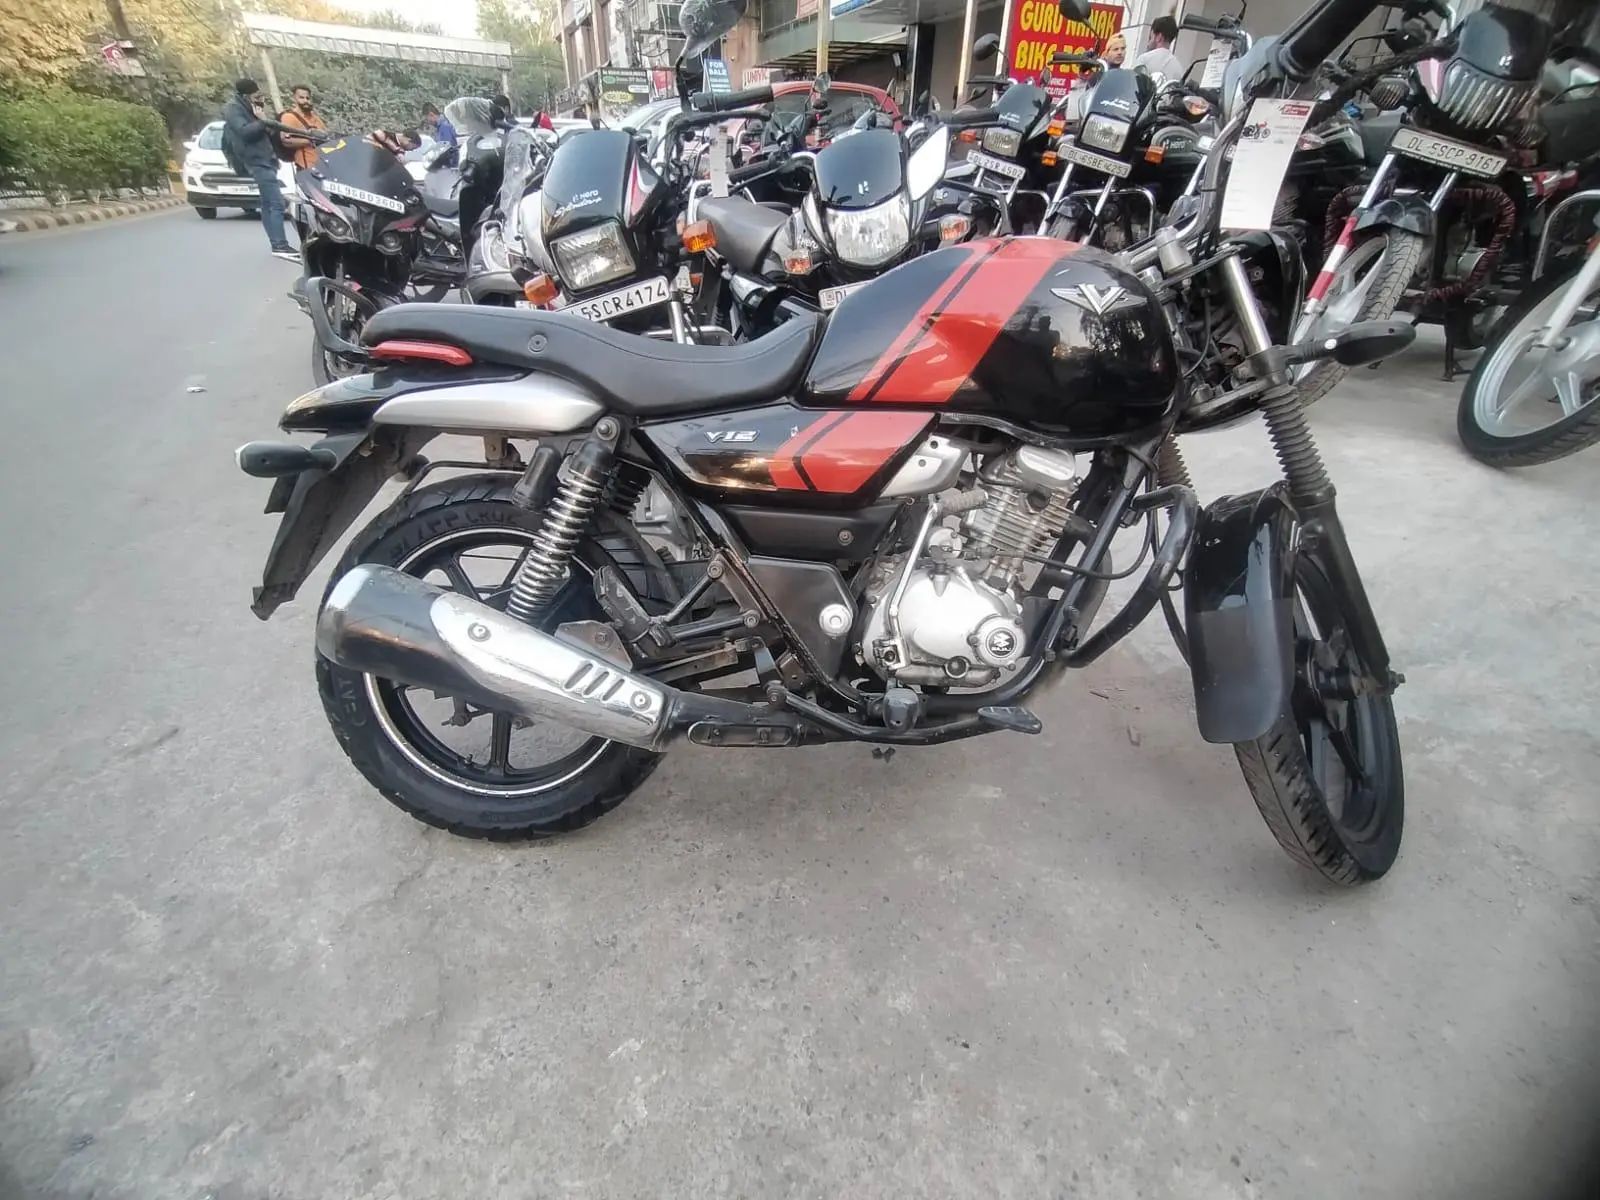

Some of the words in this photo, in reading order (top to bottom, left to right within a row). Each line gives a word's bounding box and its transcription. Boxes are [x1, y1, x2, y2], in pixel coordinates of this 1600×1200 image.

[1020, 0, 1063, 34] GURU
[1015, 40, 1057, 73] BIKE
[1465, 153, 1501, 172] 9161
[571, 279, 666, 320] 5SCR4174
